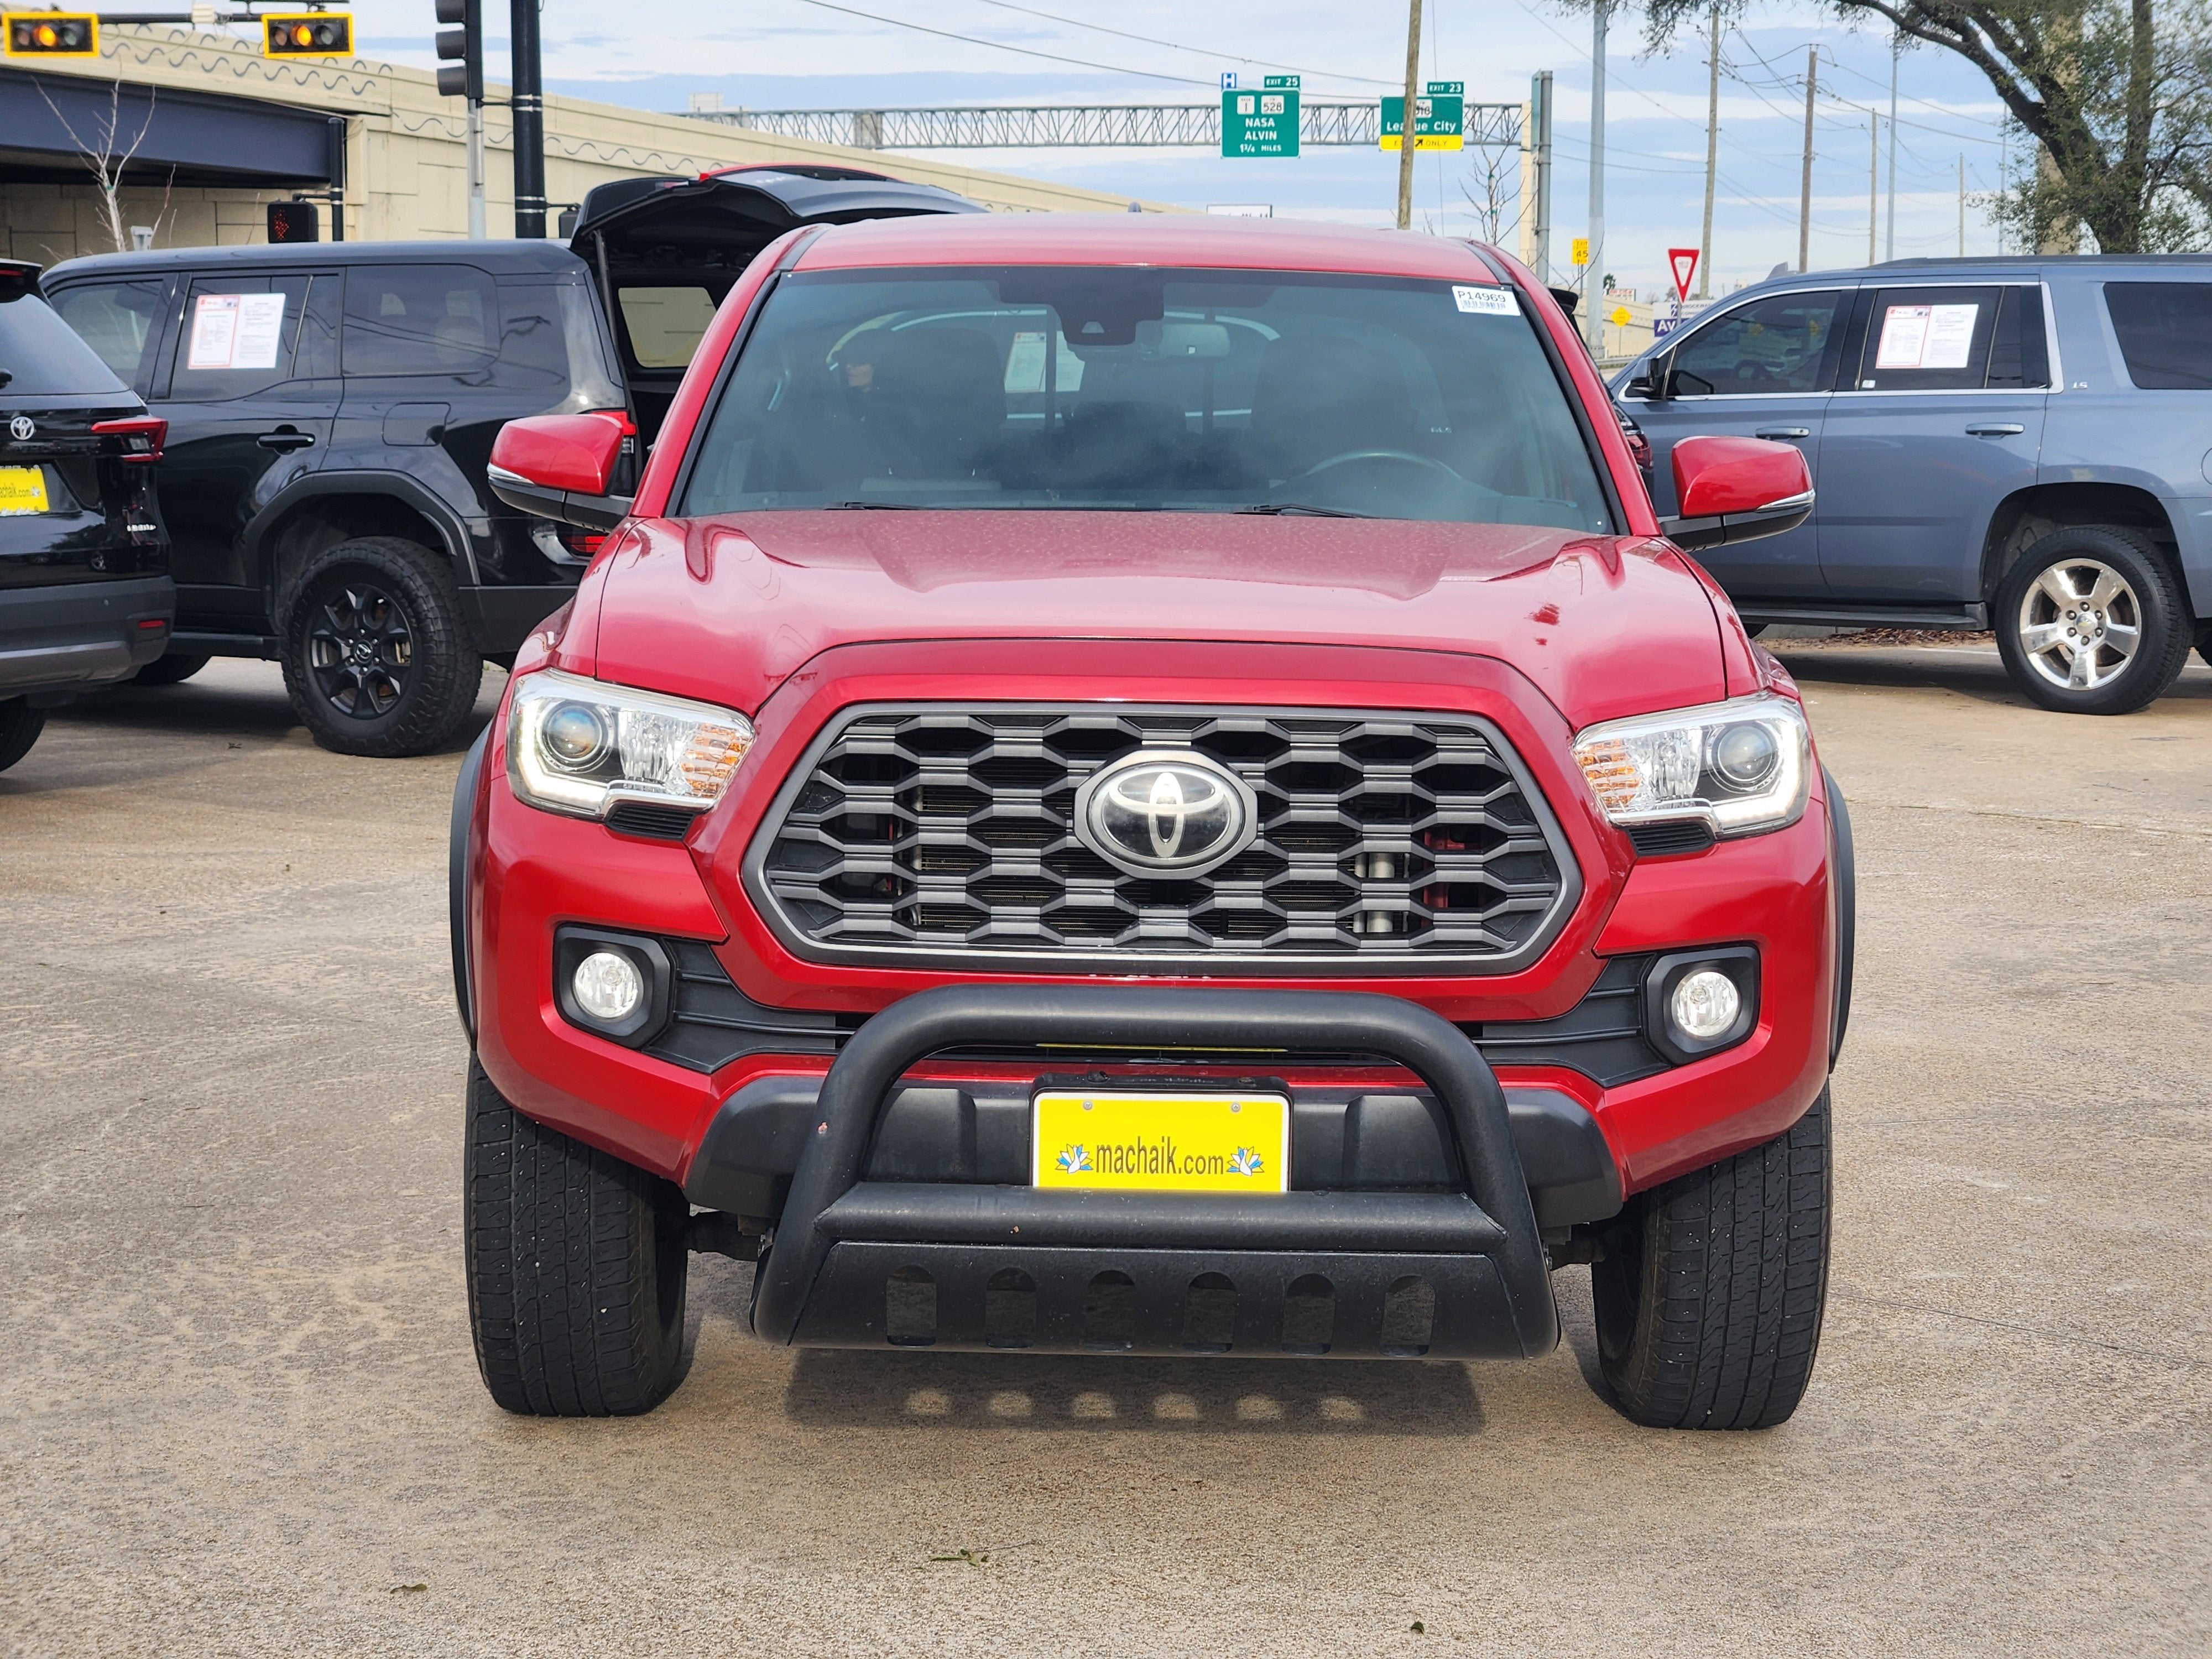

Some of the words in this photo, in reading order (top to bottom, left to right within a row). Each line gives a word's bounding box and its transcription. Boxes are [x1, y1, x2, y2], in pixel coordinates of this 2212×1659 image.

[1286, 77, 1298, 86] 25
[1449, 84, 1462, 92] 23
[1263, 102, 1282, 112] 528
[1245, 117, 1275, 128] NASA
[1433, 121, 1456, 133] City
[1244, 131, 1277, 140] ALVIN
[1458, 290, 1506, 302] P14969
[1095, 1135, 1224, 1175] machaik.com
